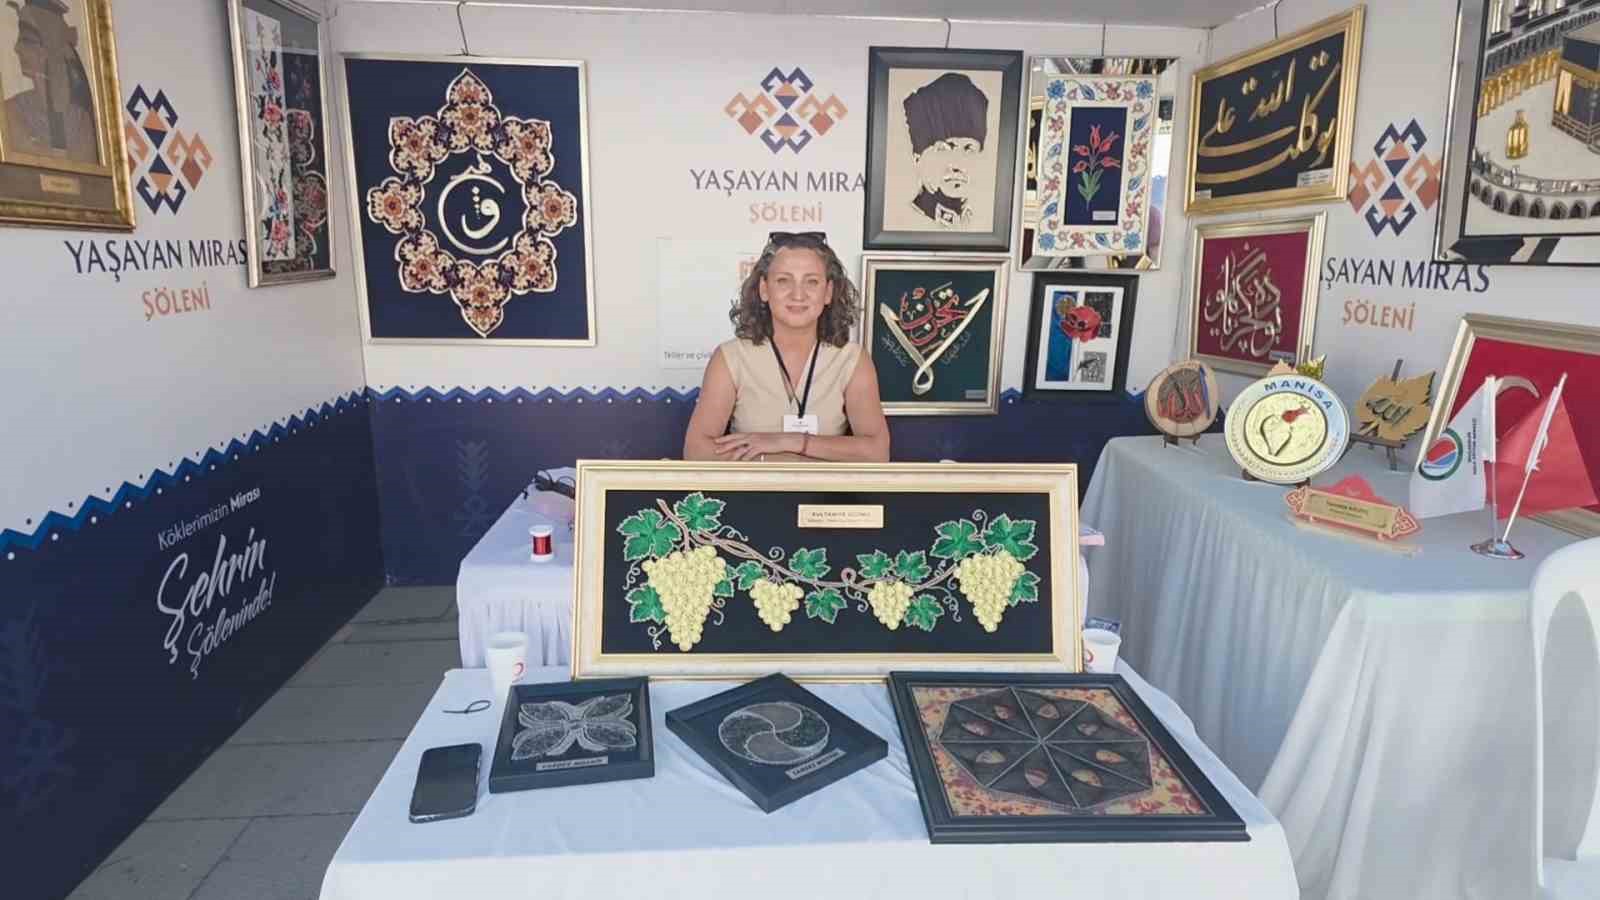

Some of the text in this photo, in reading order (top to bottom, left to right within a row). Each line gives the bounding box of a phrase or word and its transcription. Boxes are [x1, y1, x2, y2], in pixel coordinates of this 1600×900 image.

[690, 169, 866, 197] YAŞAYAN MİRA
[749, 201, 823, 225] ŞÖLENİ
[64, 239, 248, 283] YAŞAYAN MİRAS
[1319, 257, 1491, 293] ŞAYAN MİRAS
[142, 283, 211, 321] ŞÖLENİ
[1343, 299, 1415, 331] ŞÖLENİ
[1263, 380, 1334, 409] MANİSA
[158, 487, 261, 551] Köklerimizin Mirası
[157, 527, 267, 665] Şehrin
[186, 571, 277, 680] Şöleninde!
